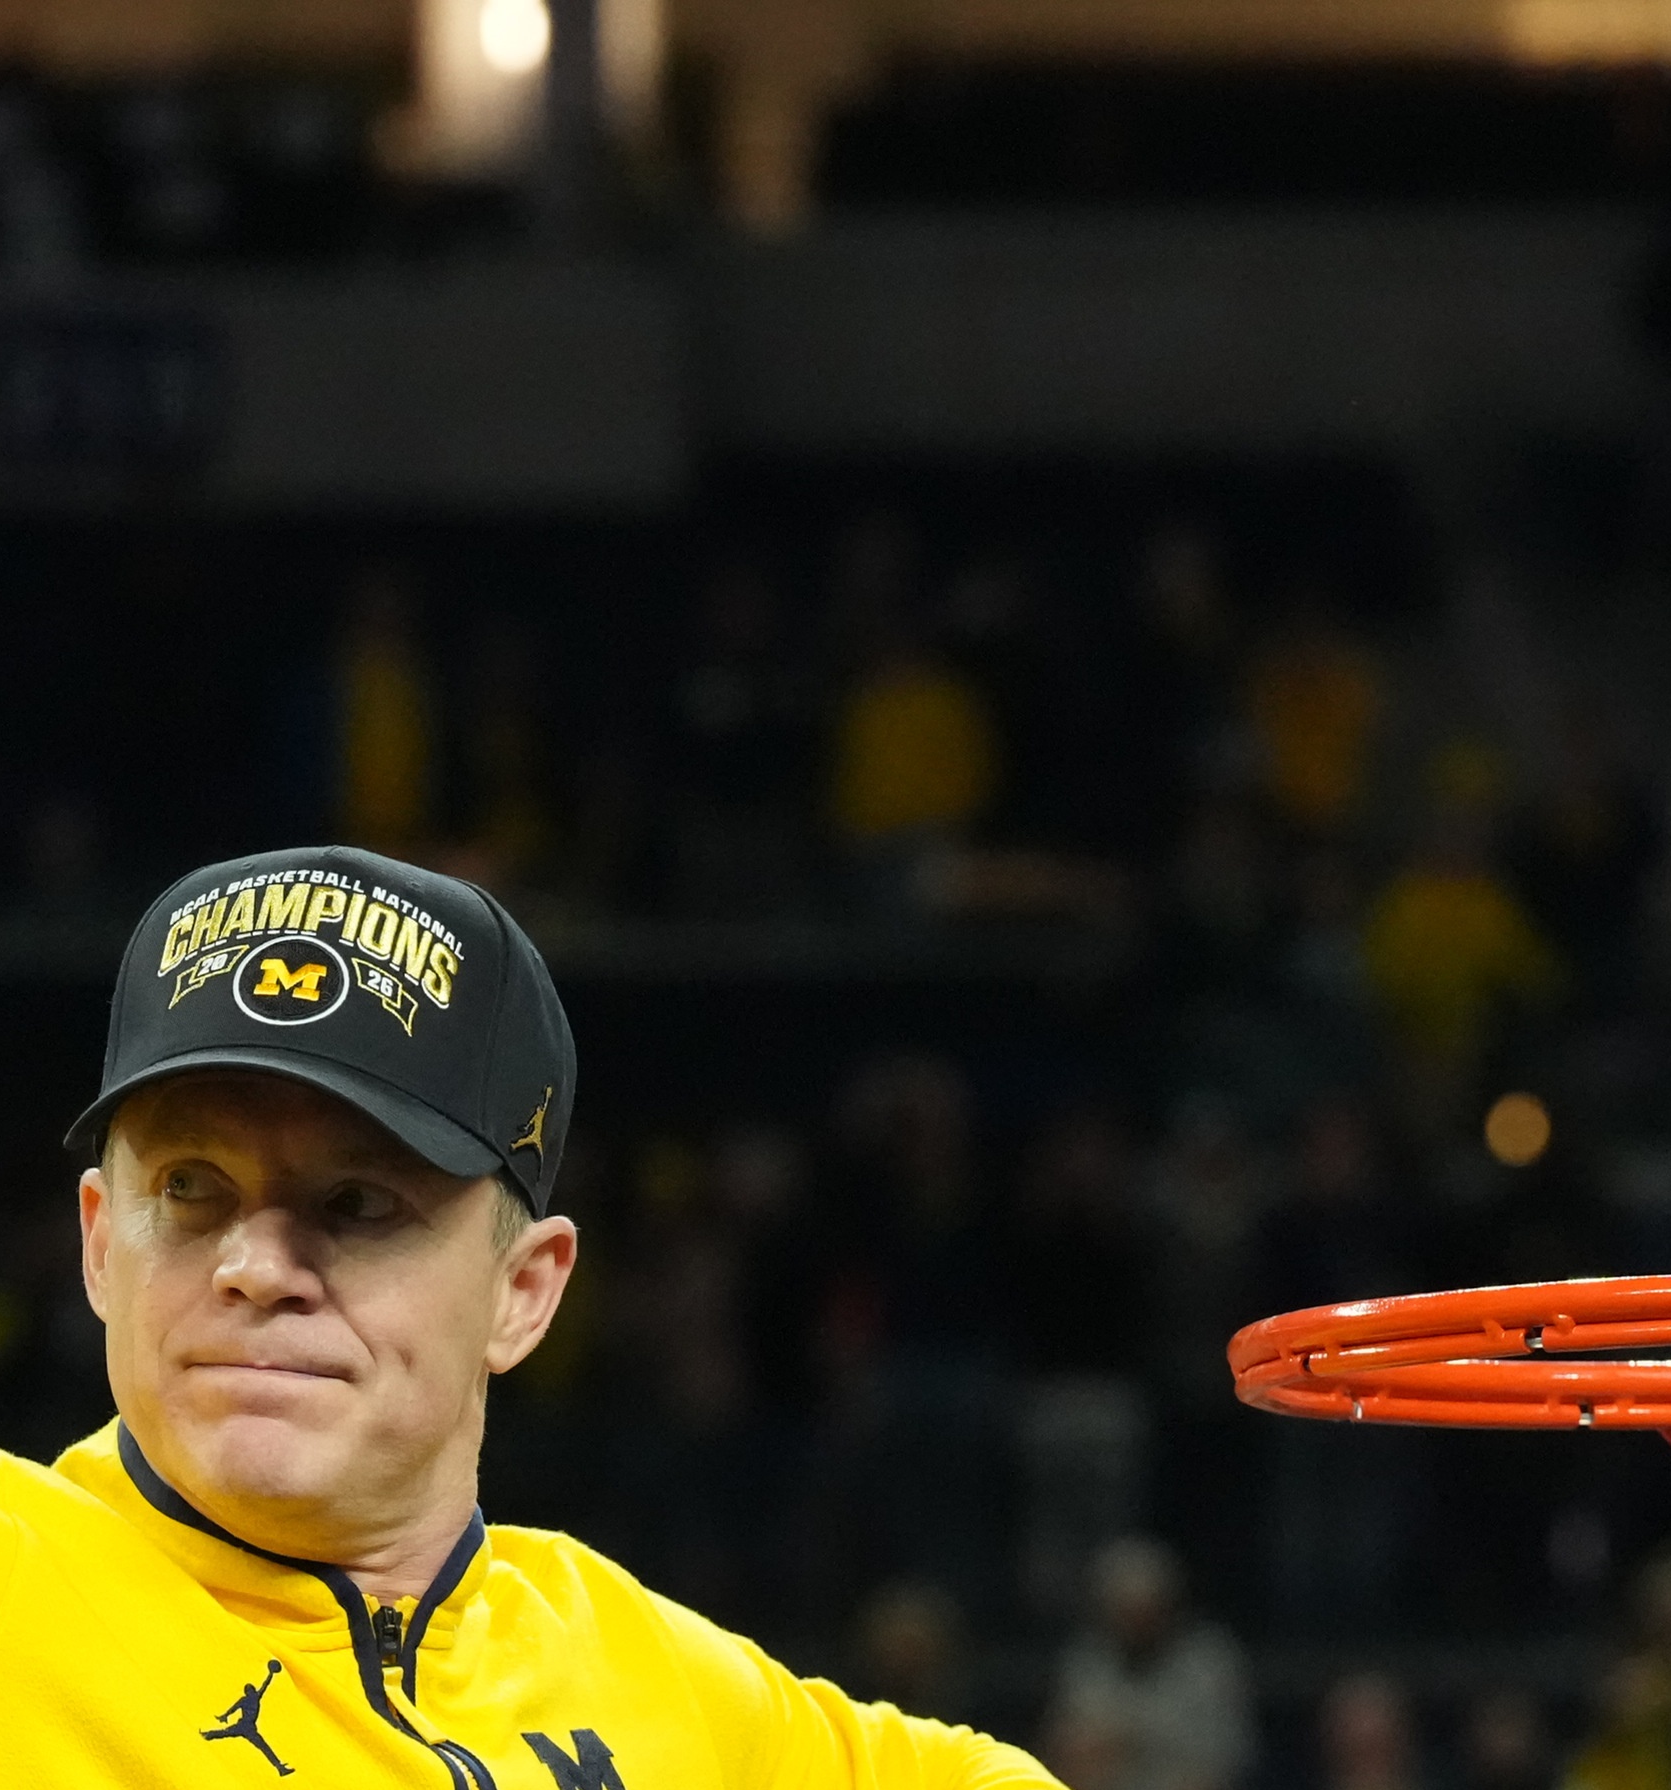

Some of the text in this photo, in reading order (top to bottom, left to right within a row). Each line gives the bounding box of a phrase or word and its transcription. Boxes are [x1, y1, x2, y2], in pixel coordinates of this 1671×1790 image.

[170, 869, 465, 961] NCAA BASKETBALL NATIONAL
[157, 882, 459, 1009] CHAMPIONS
[197, 953, 229, 977] 20
[253, 957, 328, 1002] M
[367, 969, 394, 997] 26
